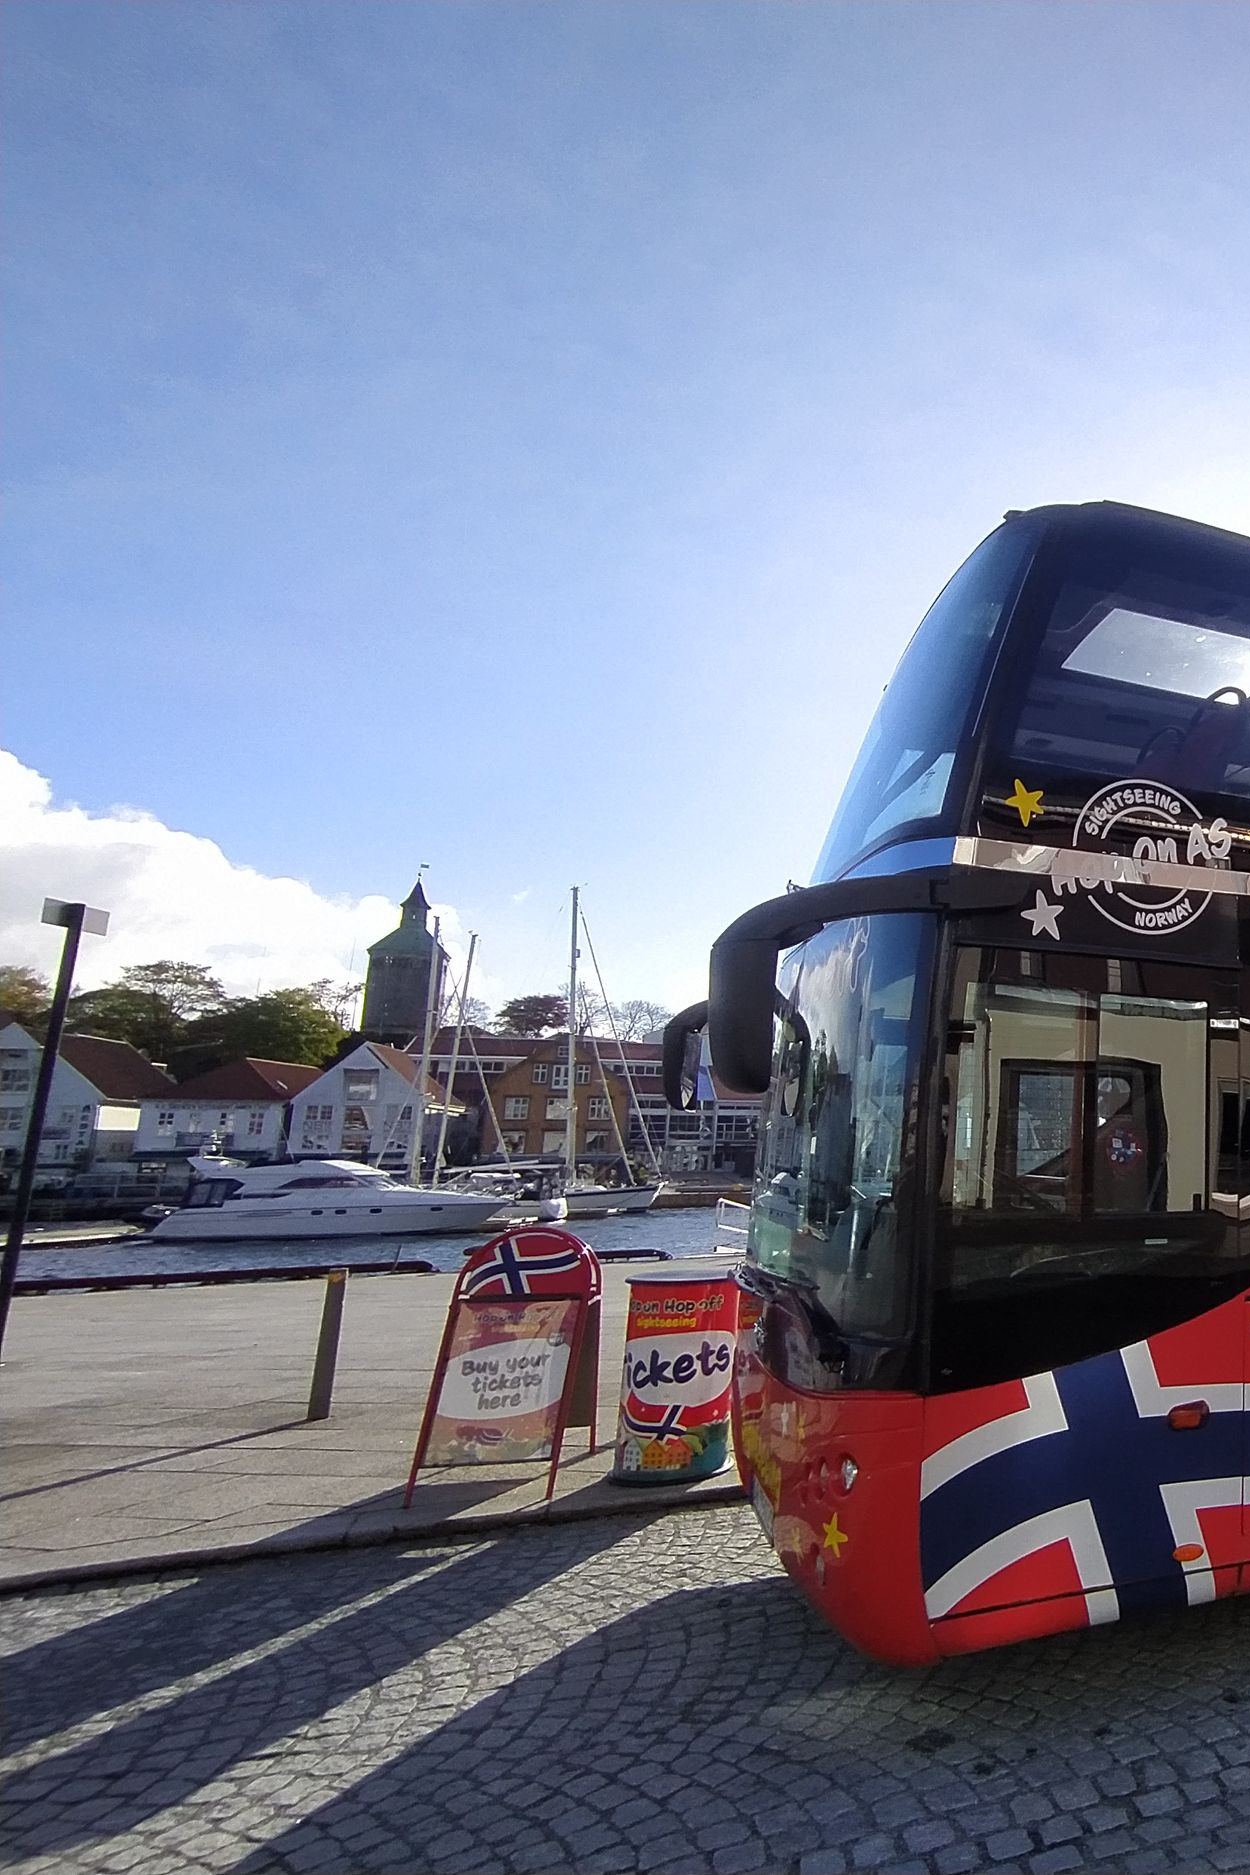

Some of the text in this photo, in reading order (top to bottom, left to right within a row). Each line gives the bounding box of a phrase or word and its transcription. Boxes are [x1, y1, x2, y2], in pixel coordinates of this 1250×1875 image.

[1085, 788, 1181, 835] SIGHTSEEING
[1187, 817, 1231, 865] AS
[1134, 897, 1193, 928] NORWAY
[663, 1298, 696, 1316] Hop
[697, 1295, 724, 1311] off
[461, 1353, 551, 1377] Buy your
[624, 1340, 732, 1389] ickets
[472, 1371, 542, 1394] tickets
[477, 1392, 522, 1411] here
